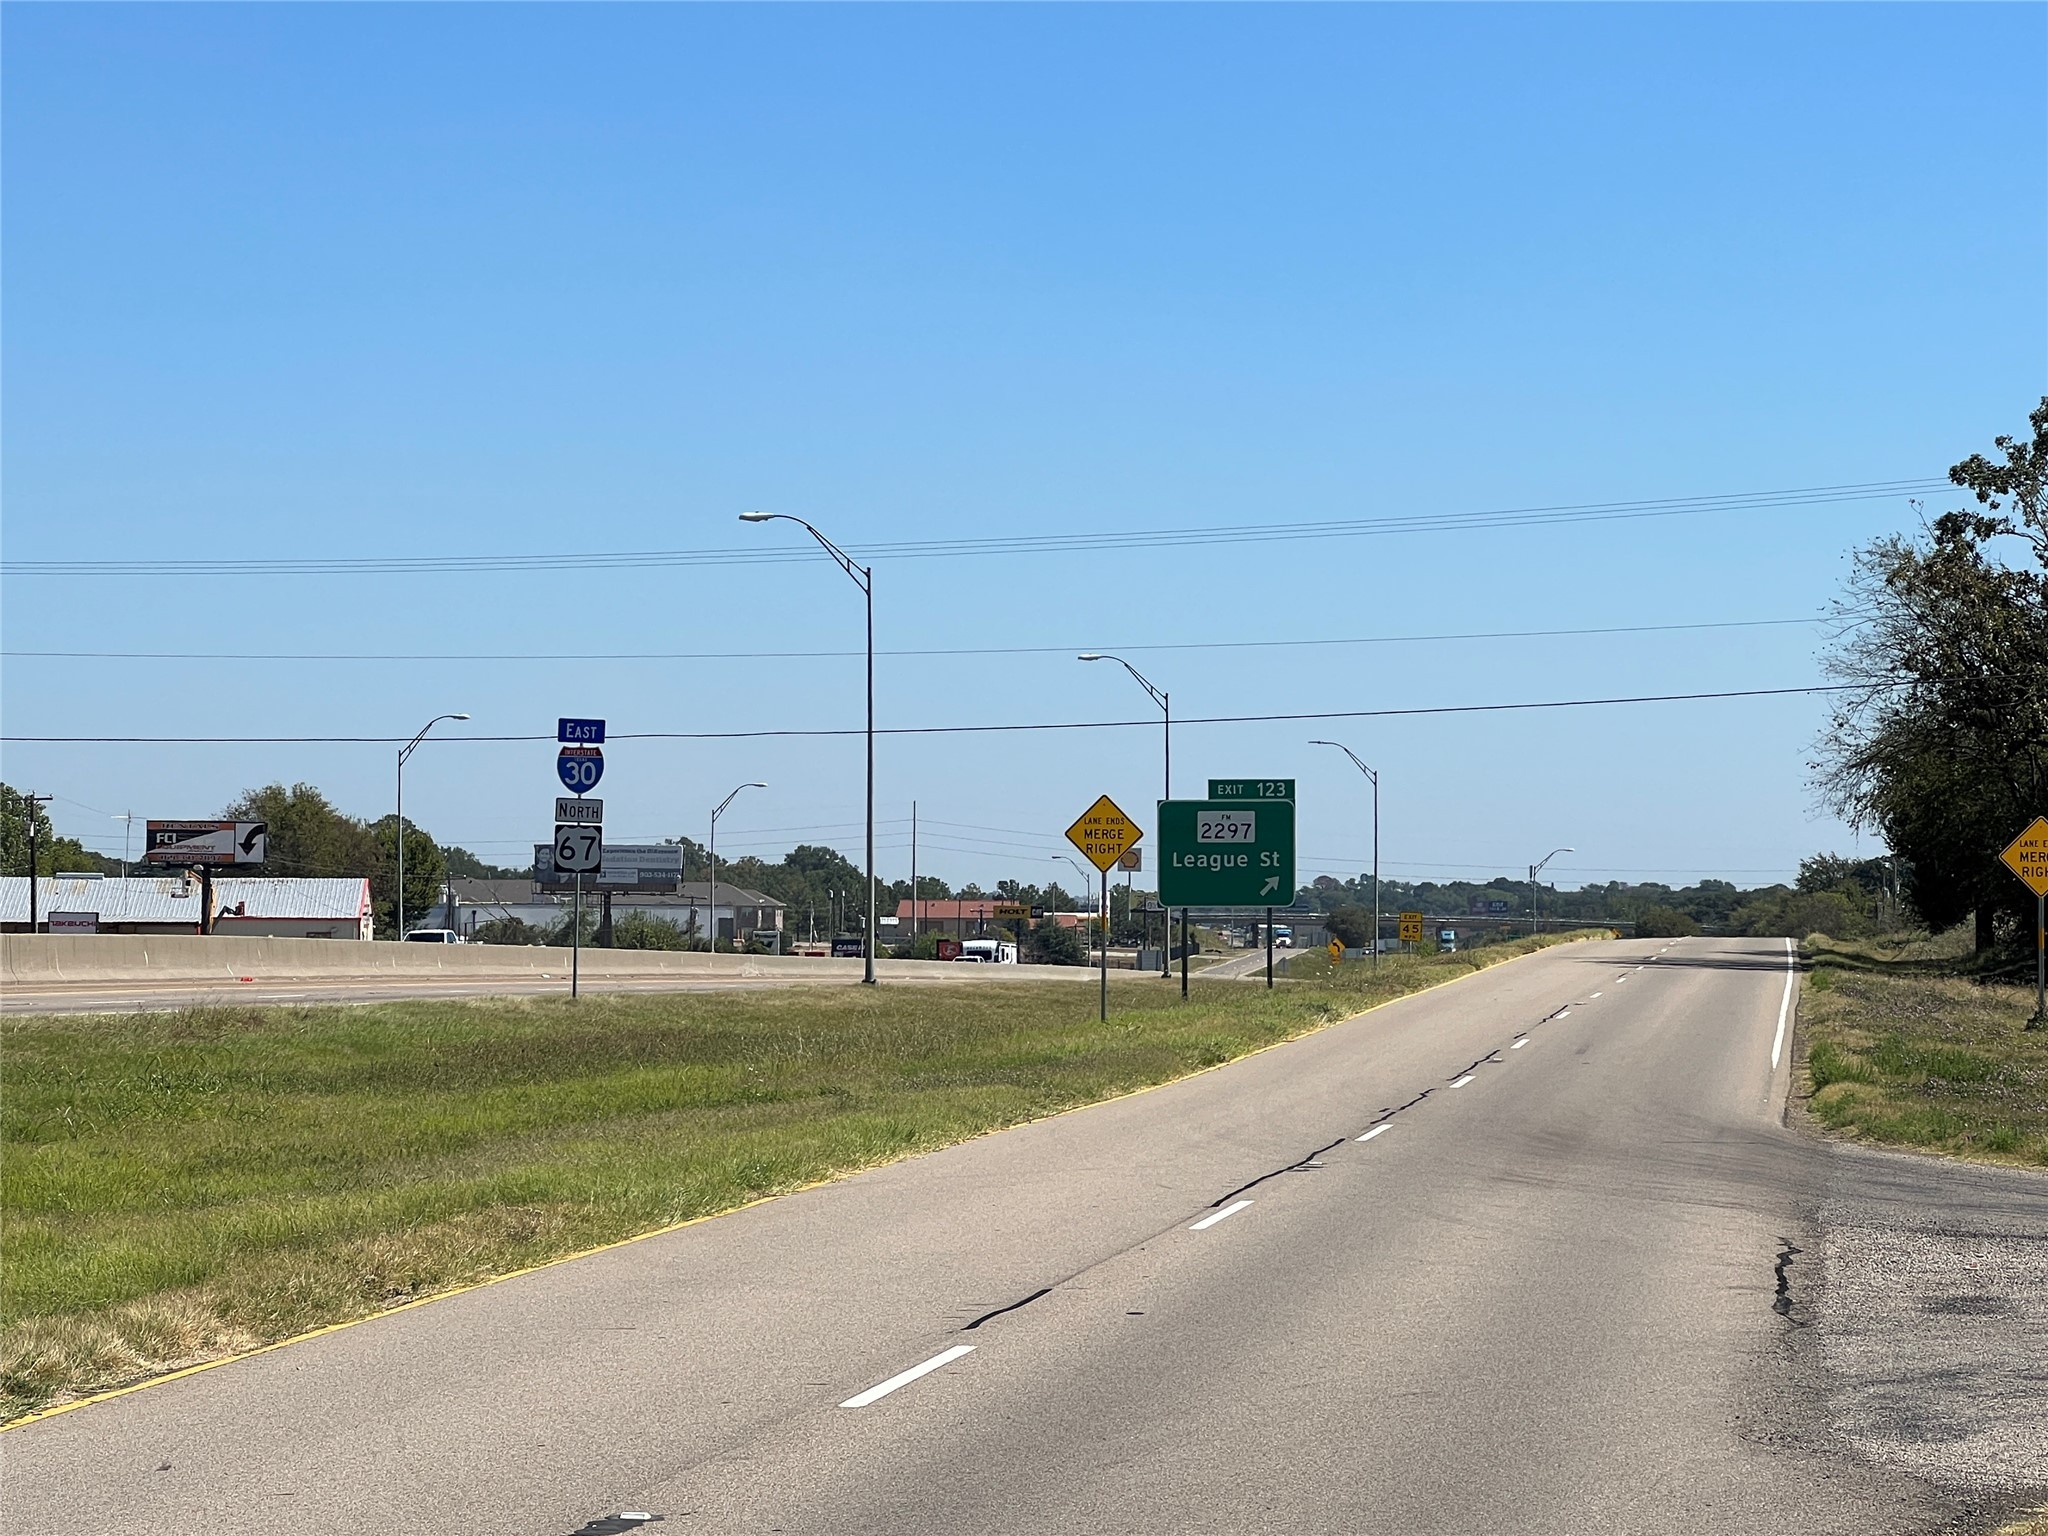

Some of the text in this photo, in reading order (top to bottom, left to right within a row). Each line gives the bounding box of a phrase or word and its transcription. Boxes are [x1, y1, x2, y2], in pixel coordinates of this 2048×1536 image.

[566, 723, 597, 739] EAST
[564, 762, 596, 785] 30
[1217, 783, 1286, 796] EXIT 123
[559, 803, 599, 819] NORTH
[1084, 817, 1125, 825] LANE ENDS
[1084, 829, 1124, 840] MERGE
[1201, 823, 1252, 839] 2297
[156, 832, 177, 844] FCI
[2020, 840, 2039, 848] LANE
[559, 836, 597, 861] 67
[1086, 844, 1123, 854] RIGHT
[1173, 852, 1280, 871] League St
[2020, 851, 2048, 862] MER
[1402, 924, 1419, 933] 45
